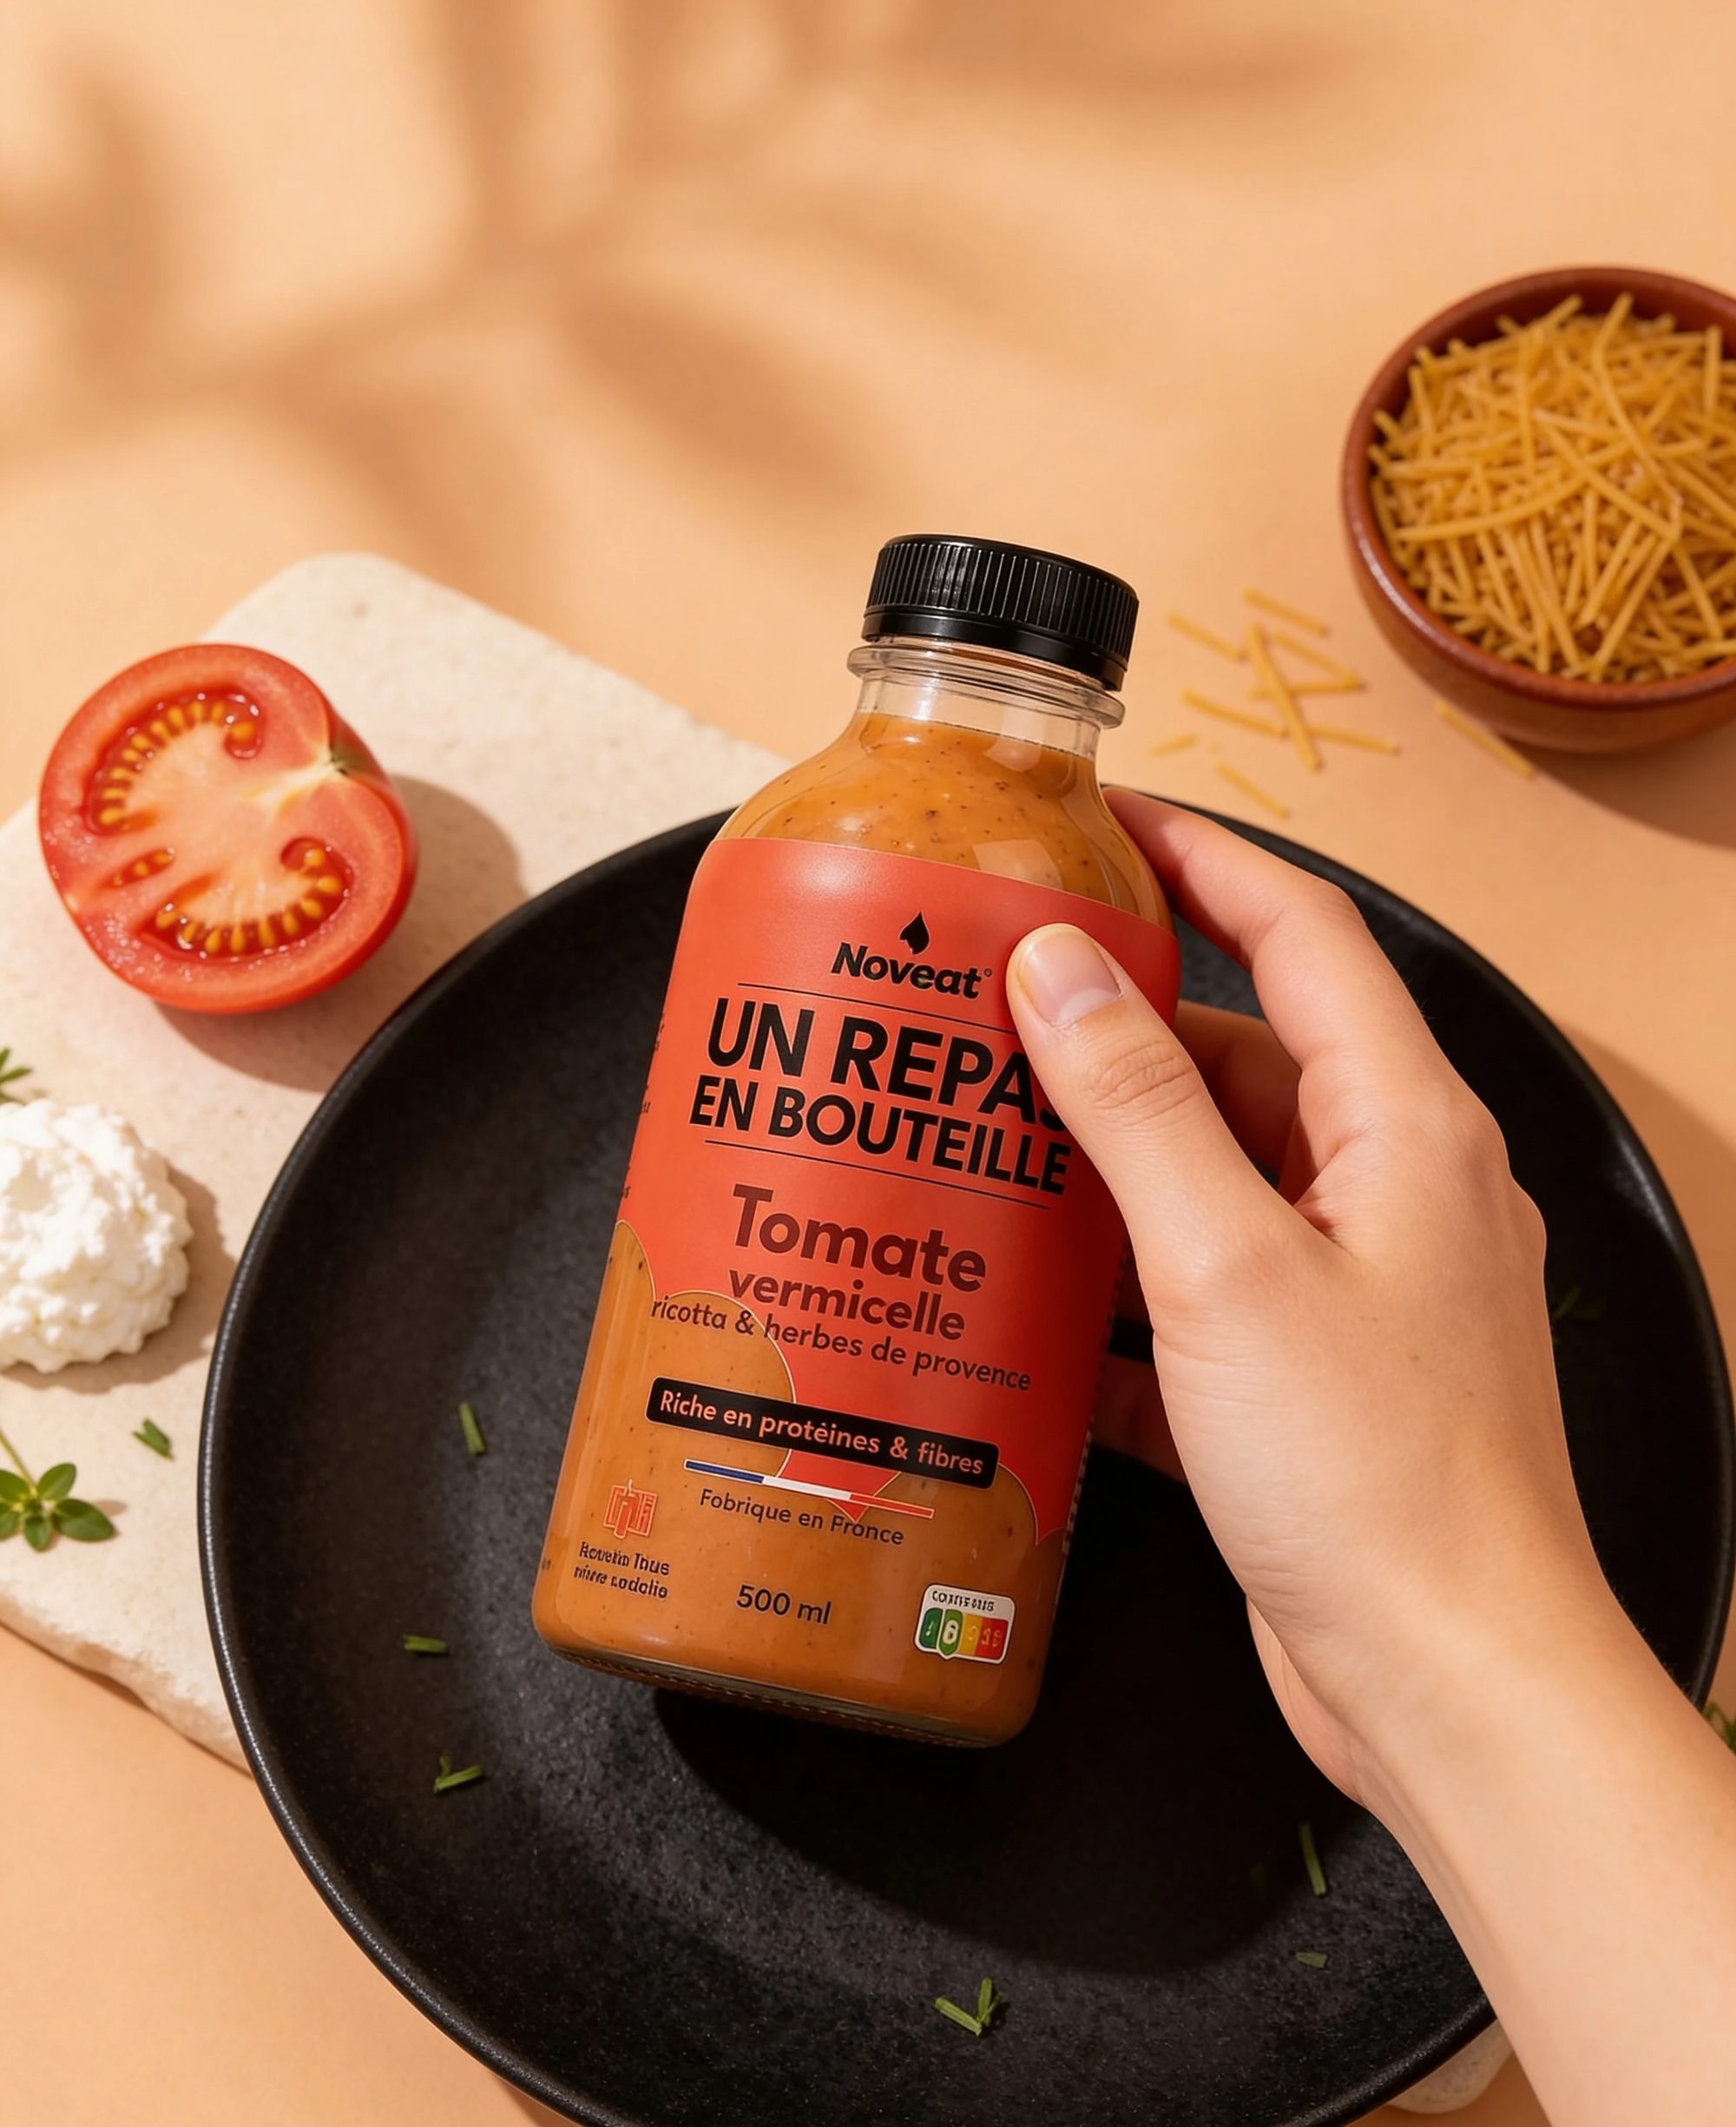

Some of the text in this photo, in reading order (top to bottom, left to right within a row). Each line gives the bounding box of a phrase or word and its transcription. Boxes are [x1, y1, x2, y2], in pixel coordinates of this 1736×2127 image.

[707, 998, 814, 1077] UN
[690, 1075, 1073, 1195] EN BOUTEILLE
[732, 1183, 987, 1292] Tomate
[650, 1295, 1032, 1392] ricotta & herbes de provence
[729, 1268, 966, 1341] vermicelle
[660, 1389, 717, 1421] Riche
[723, 1409, 753, 1430] en
[889, 1435, 909, 1460] &
[917, 1441, 983, 1475] fibres
[798, 1511, 824, 1530] en
[737, 1584, 832, 1624] 500 ml
